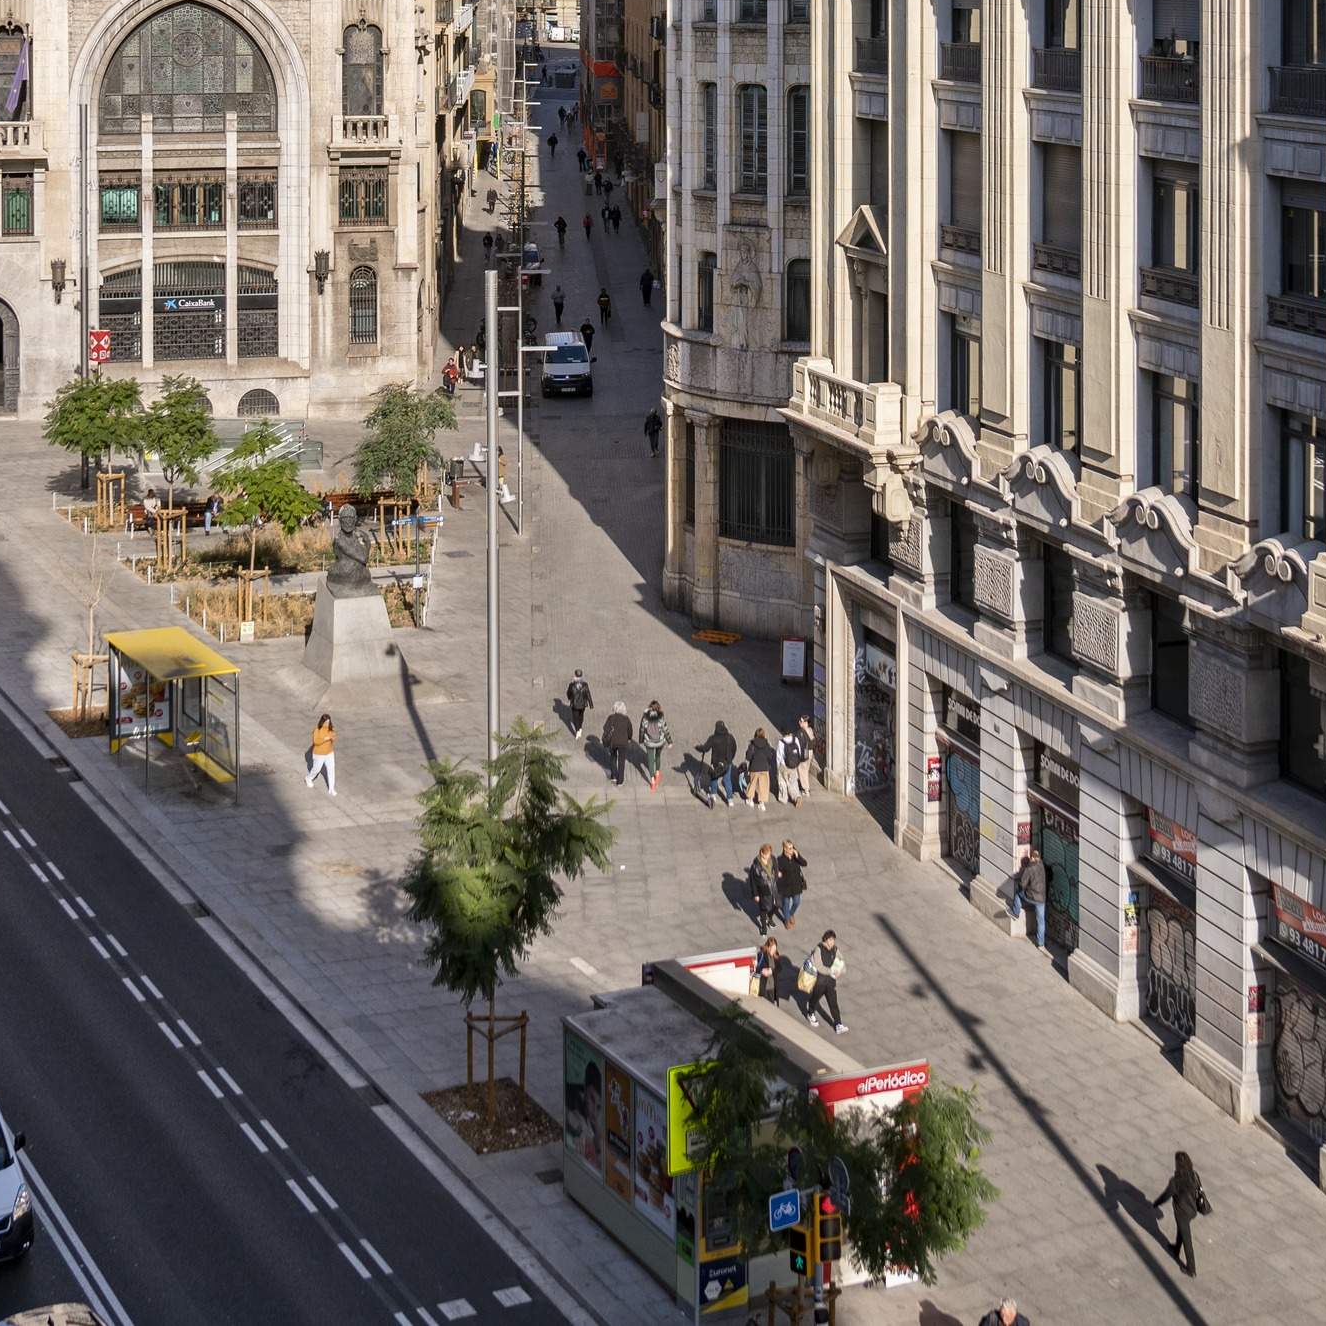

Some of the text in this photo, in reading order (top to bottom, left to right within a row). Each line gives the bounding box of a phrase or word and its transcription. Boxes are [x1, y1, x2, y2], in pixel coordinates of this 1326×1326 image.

[178, 298, 215, 308] CaixaBank
[1161, 847, 1171, 863] 93
[1289, 928, 1301, 947] 93
